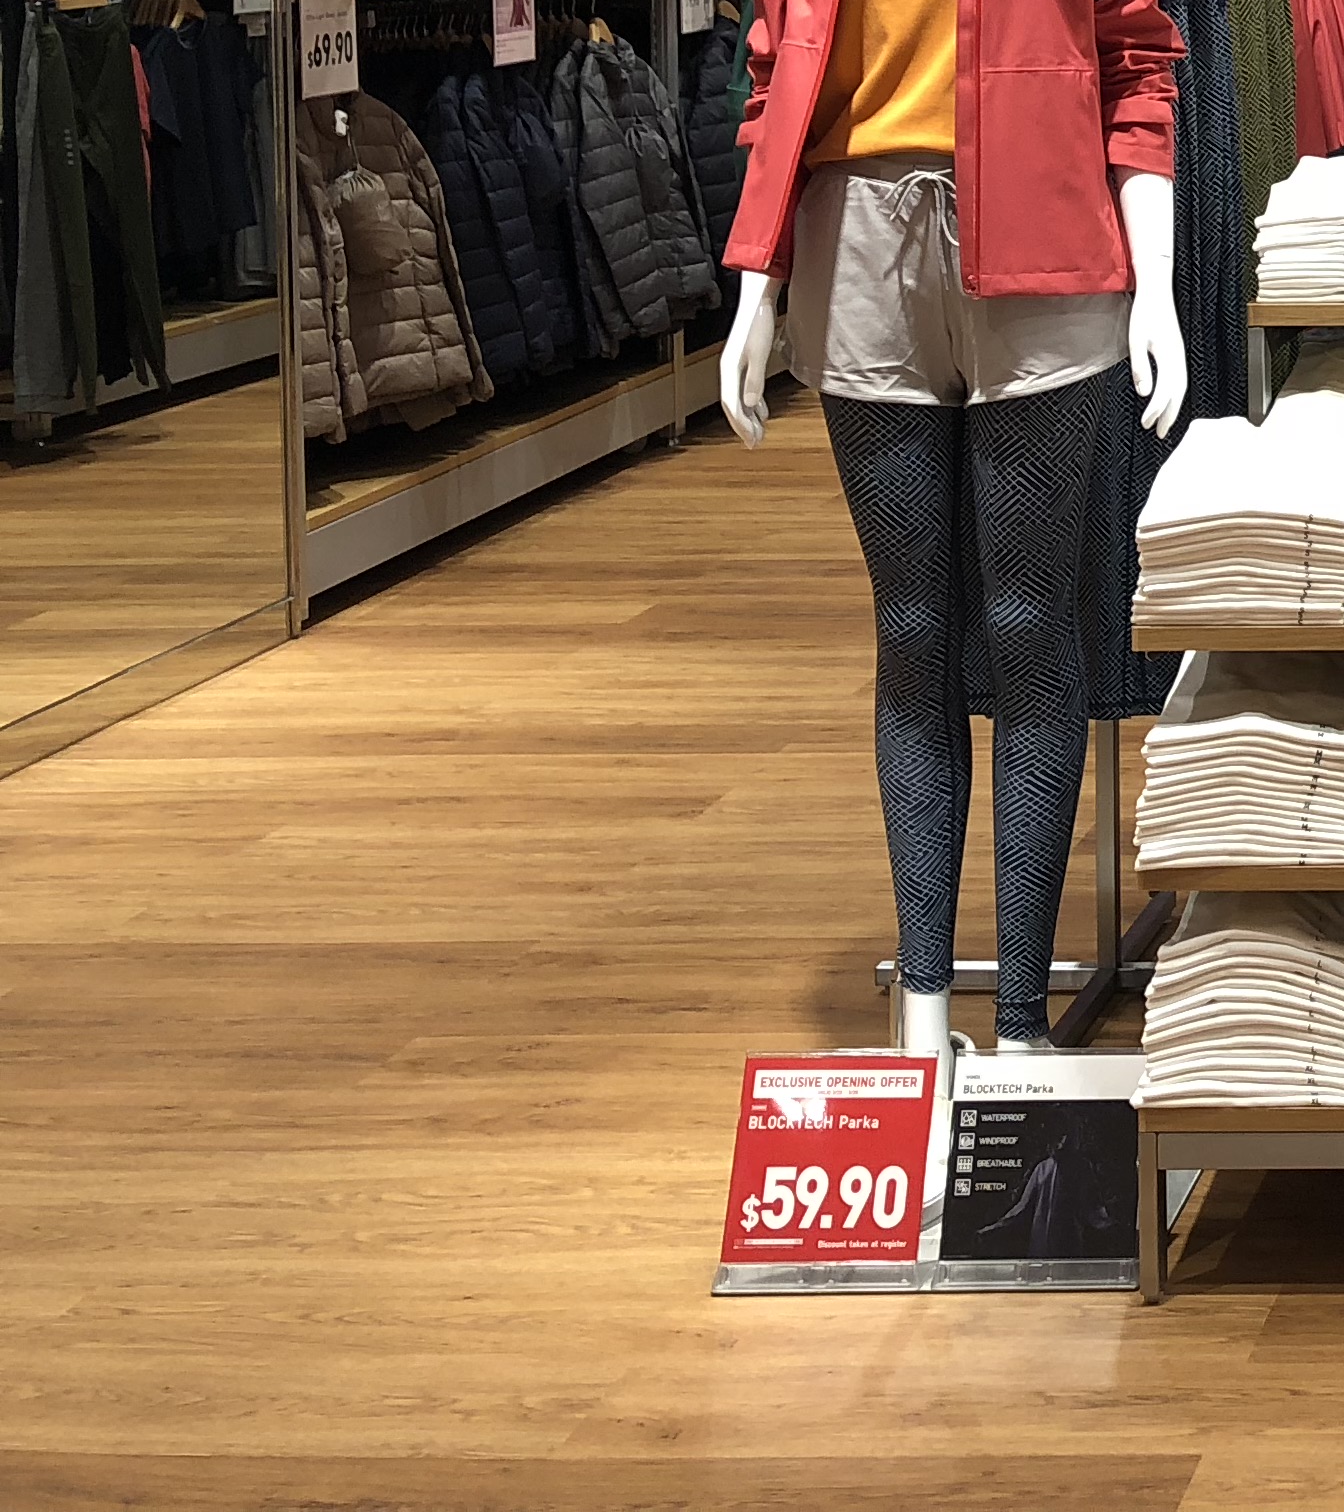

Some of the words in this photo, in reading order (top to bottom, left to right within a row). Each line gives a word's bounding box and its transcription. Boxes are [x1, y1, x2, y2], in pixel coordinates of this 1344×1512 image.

[308, 30, 353, 69] $69.90
[760, 1077, 822, 1087] EXCLUSIVE
[826, 1077, 877, 1087] OPENING
[880, 1077, 917, 1087] OFFER
[963, 1084, 1022, 1094] BLOCKTECH
[1026, 1084, 1054, 1093] Parka
[981, 1113, 1027, 1121] WATERPROOF
[748, 1115, 833, 1130] BLOCKTECH
[839, 1115, 880, 1129] Parka
[979, 1137, 1018, 1145] WINDPROOF
[977, 1159, 1022, 1167] BREATHABLE
[975, 1182, 1006, 1191] STRETCH
[740, 1166, 908, 1232] $59.90
[818, 1240, 847, 1248] Discount
[881, 1241, 907, 1249] register
